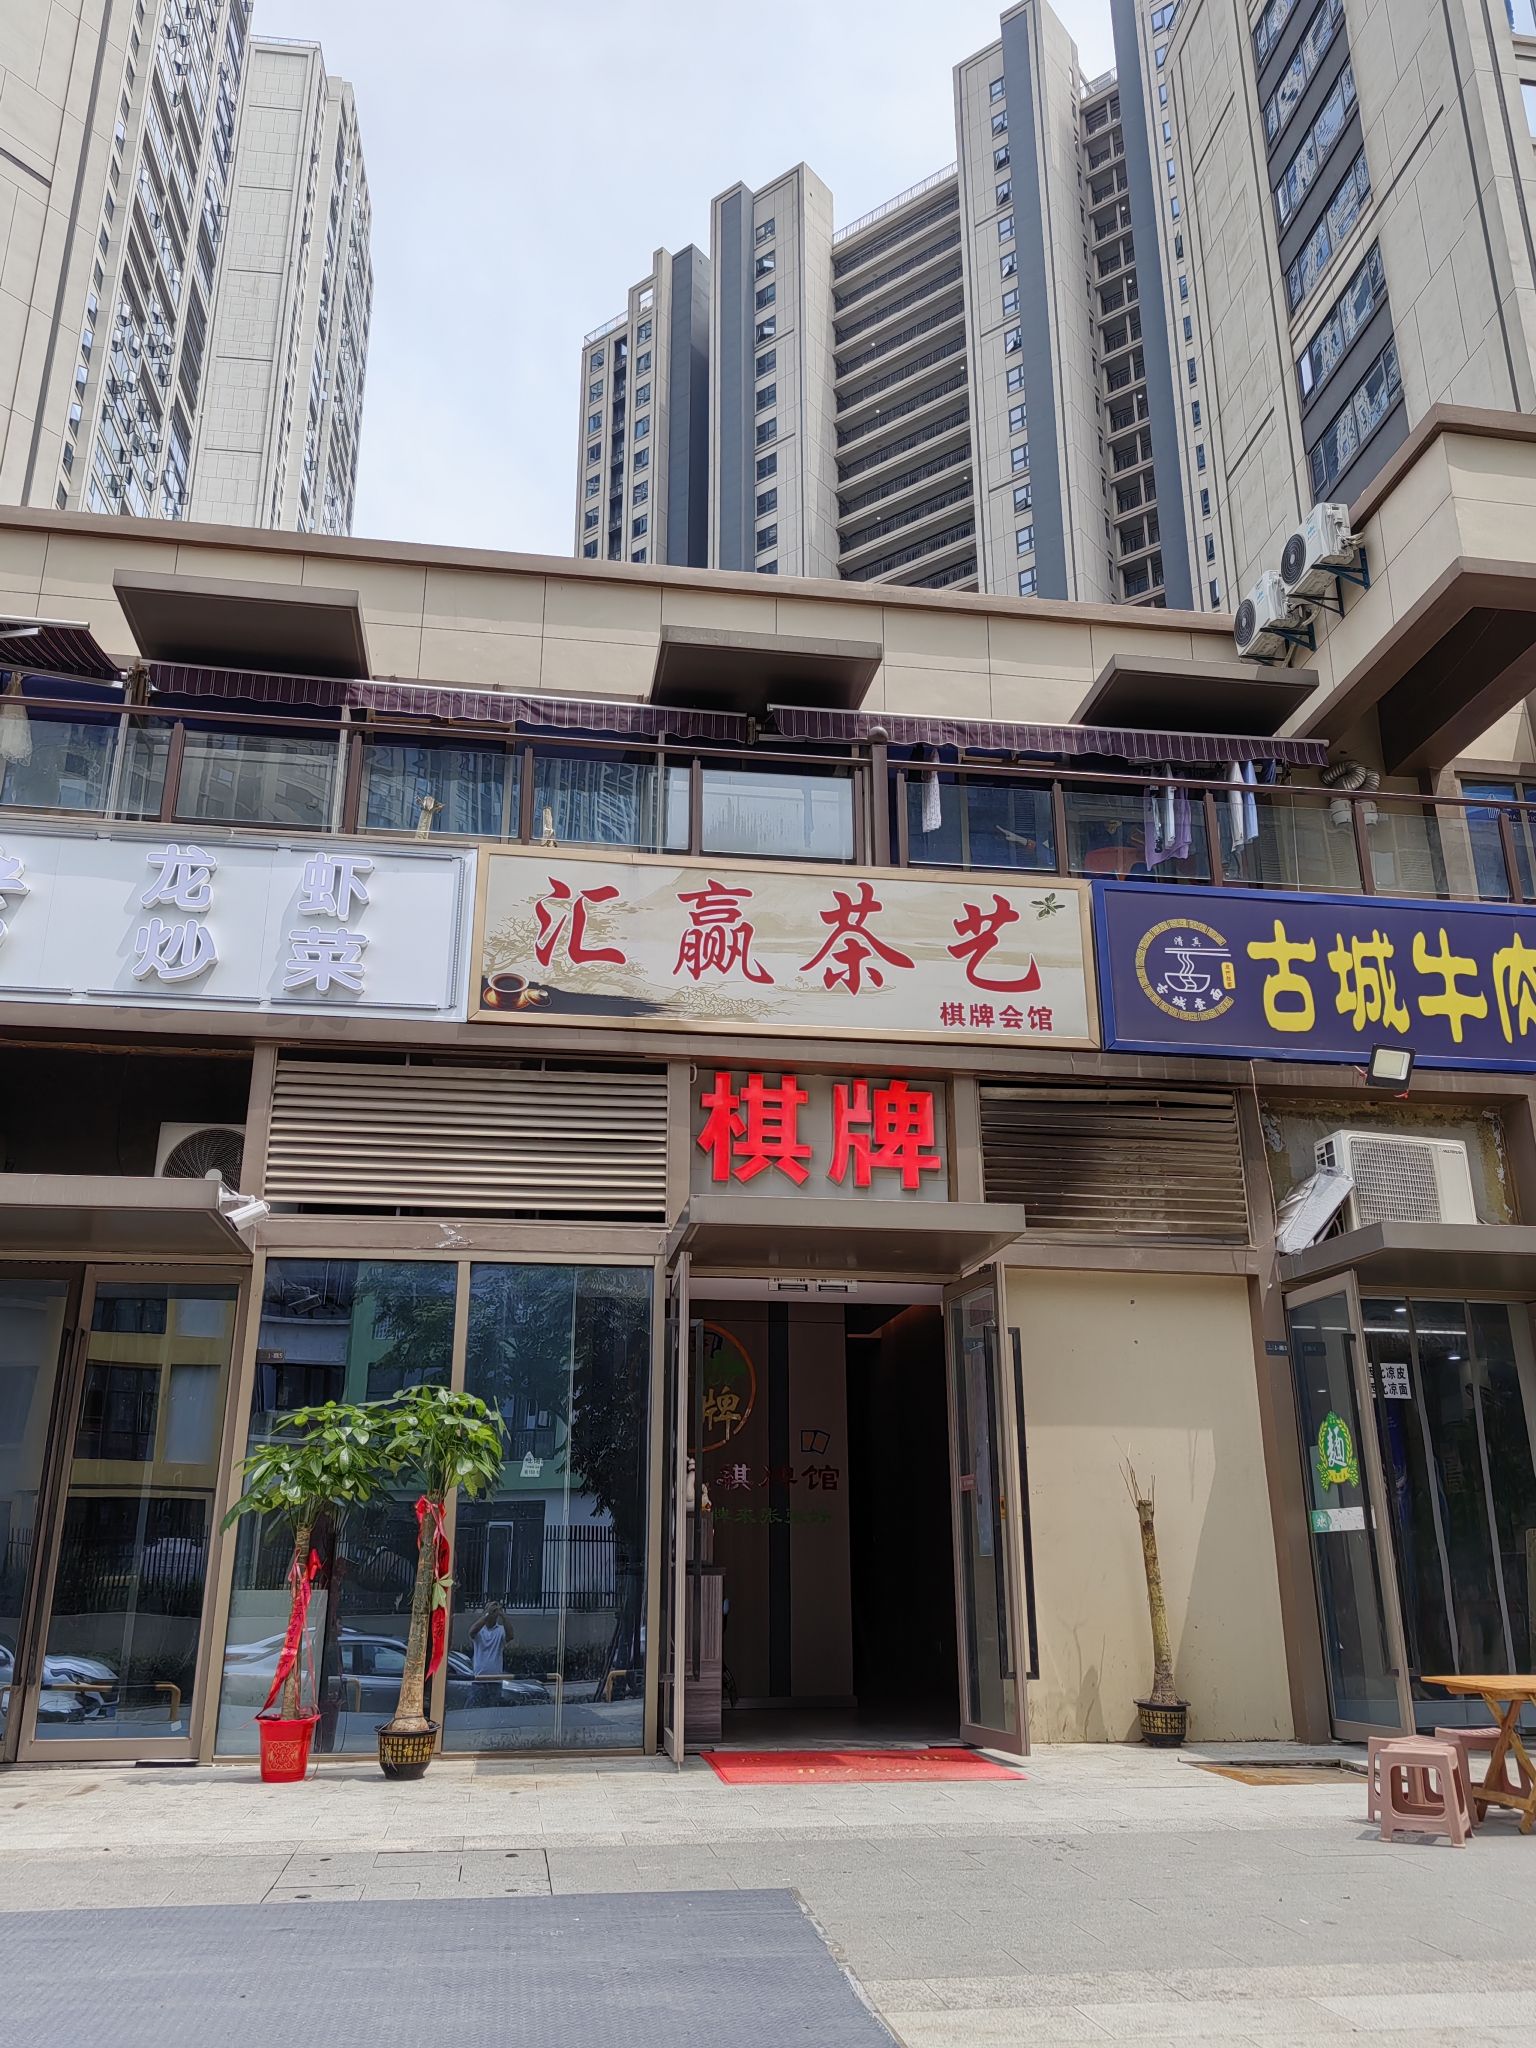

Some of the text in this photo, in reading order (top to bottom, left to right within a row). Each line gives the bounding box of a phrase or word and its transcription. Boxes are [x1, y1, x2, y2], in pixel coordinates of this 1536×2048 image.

[533, 876, 1042, 997] 汇赢茶艺
[939, 1001, 1054, 1032] 棋牌会馆
[697, 1072, 942, 1191] 棋牌
